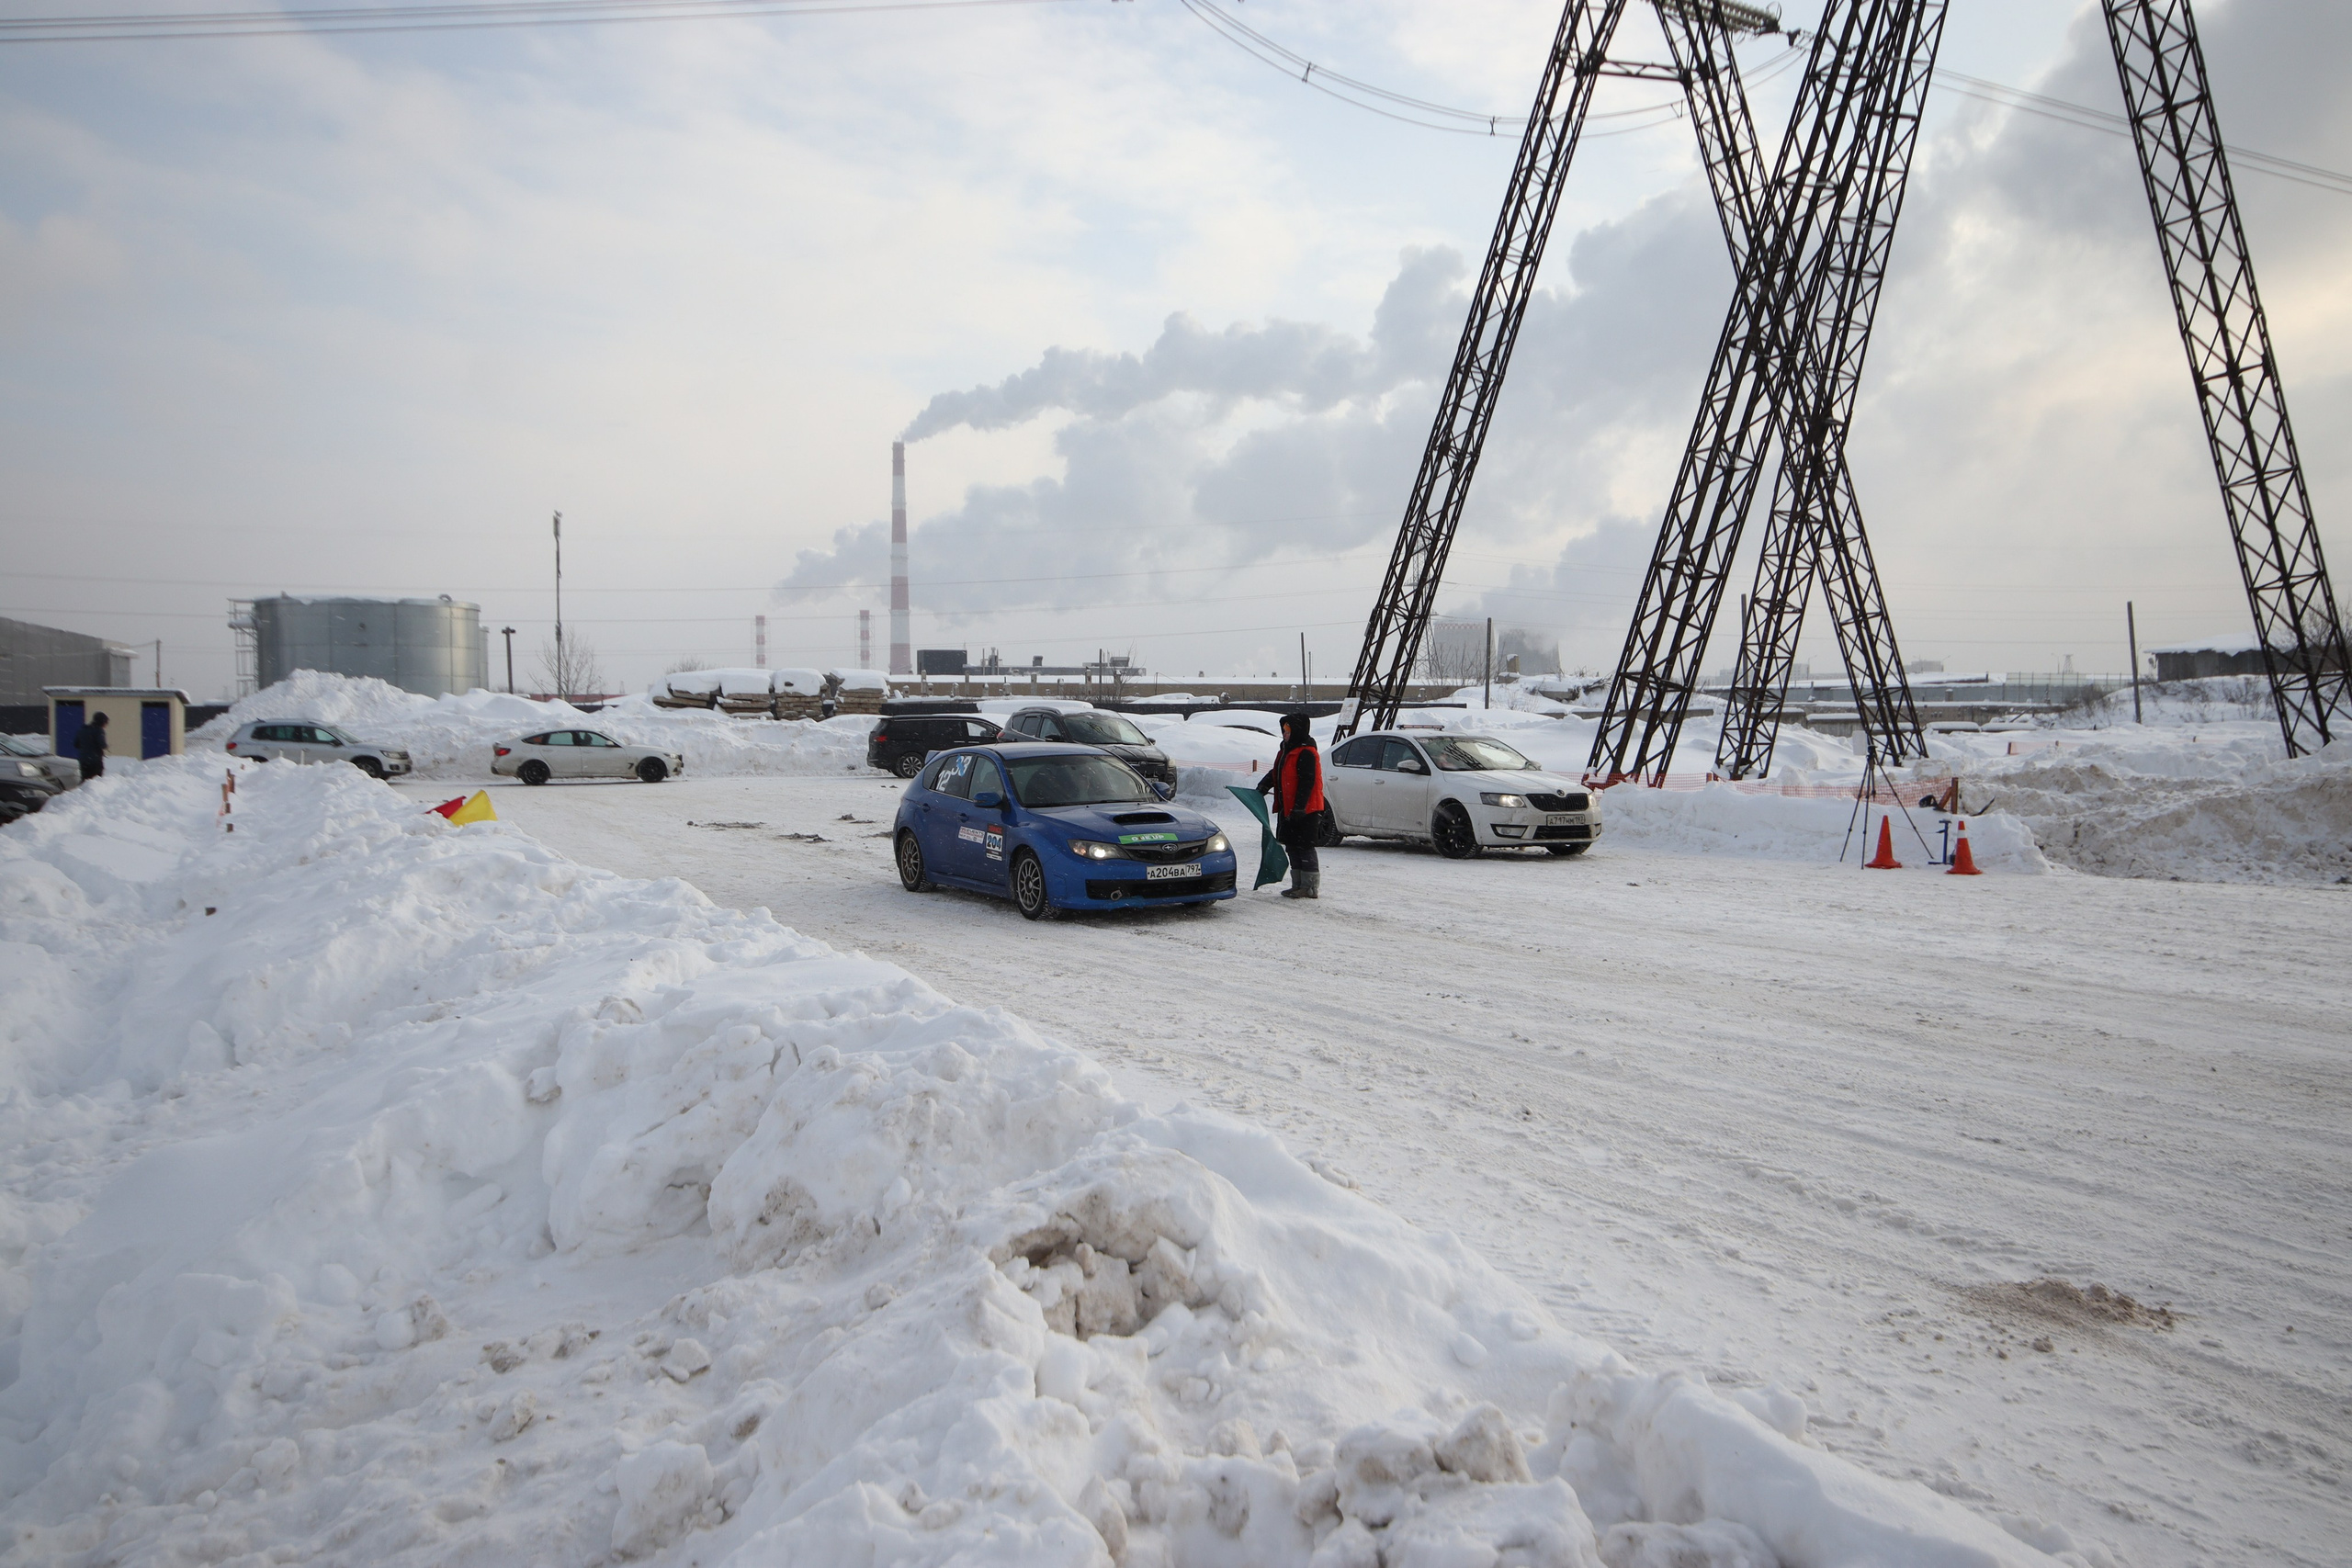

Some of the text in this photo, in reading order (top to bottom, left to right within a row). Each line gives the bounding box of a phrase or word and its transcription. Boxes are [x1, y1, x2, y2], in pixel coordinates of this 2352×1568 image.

[987, 834, 1001, 850] 204
[1149, 866, 1185, 878] А204ВА
[1187, 864, 1199, 873] 797
